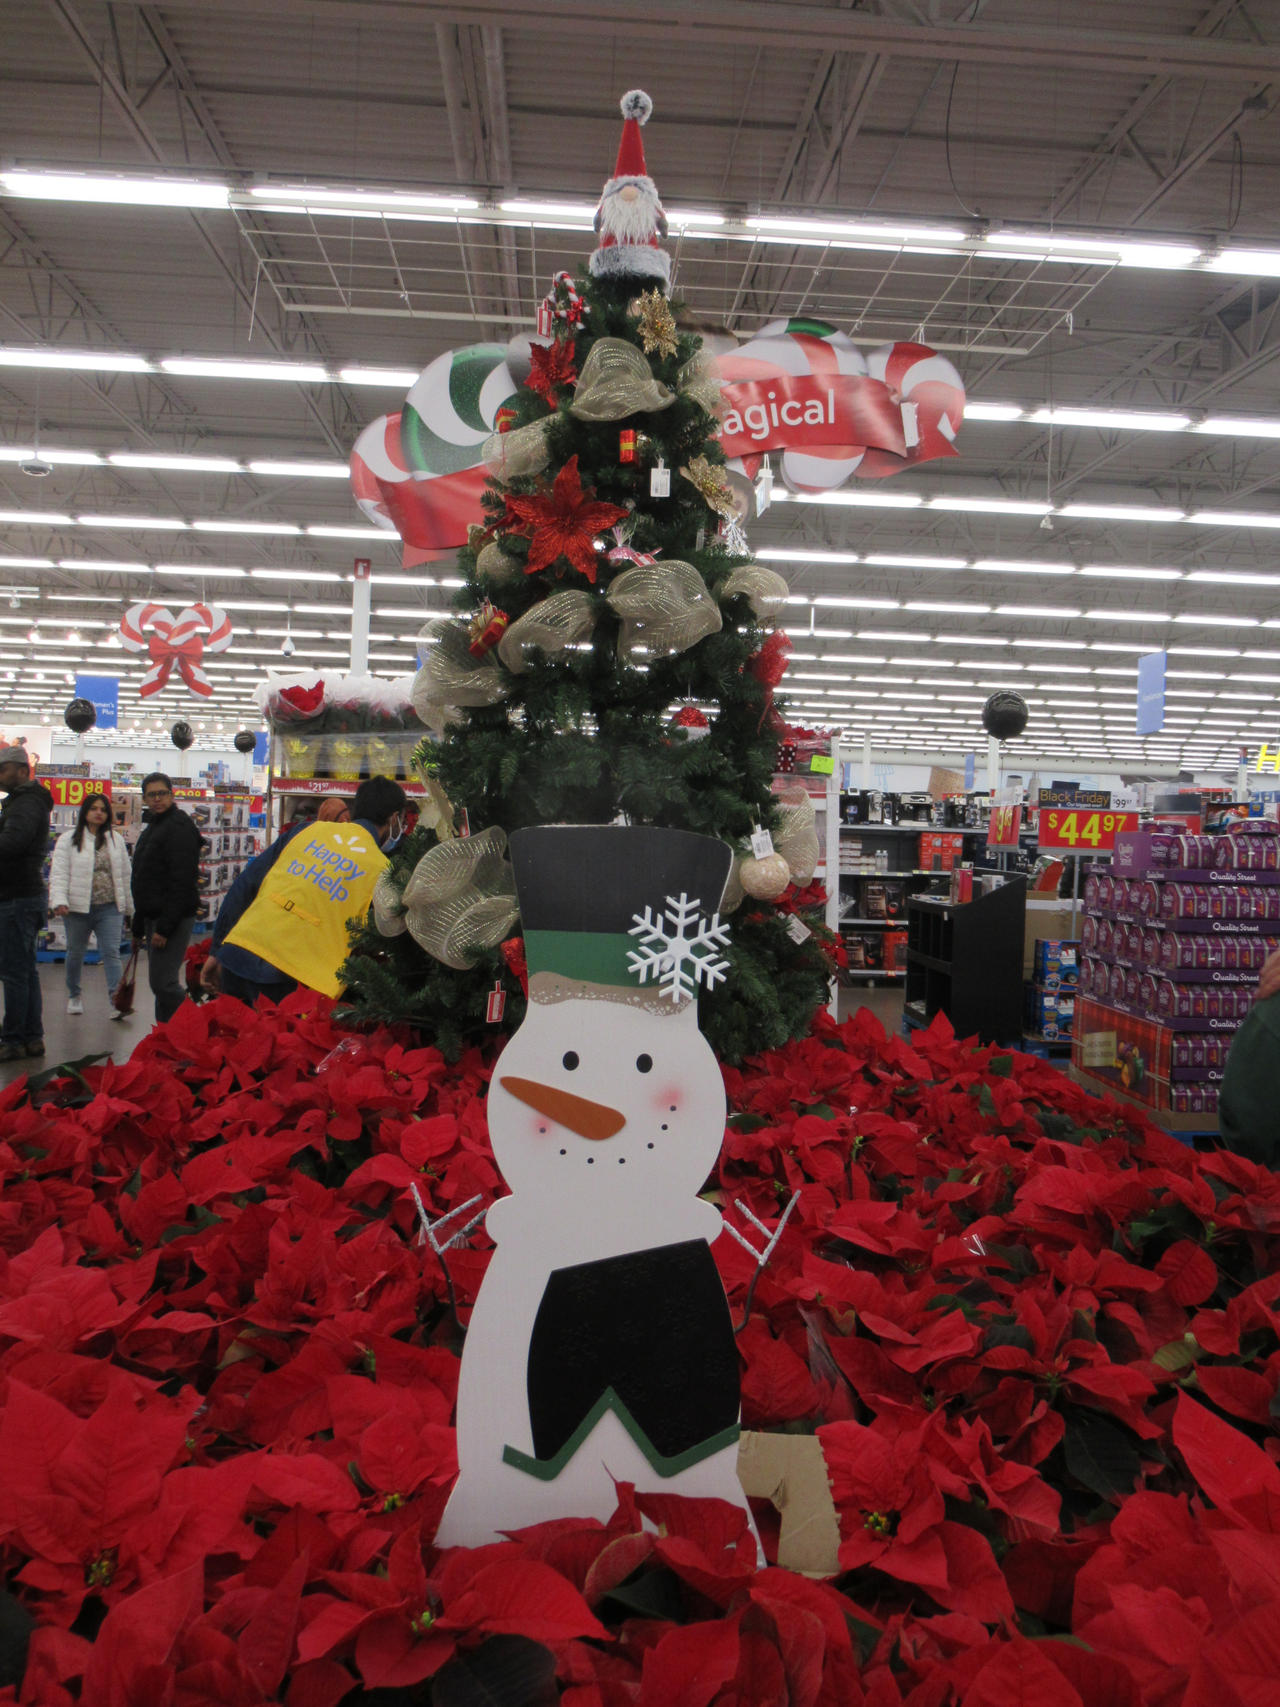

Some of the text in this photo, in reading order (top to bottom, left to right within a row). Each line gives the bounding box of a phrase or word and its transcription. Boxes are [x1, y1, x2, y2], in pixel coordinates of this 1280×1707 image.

[716, 388, 835, 440] agical
[1039, 789, 1110, 807] Black Friday
[304, 839, 366, 881] Happy
[287, 859, 349, 902] to Help
[1210, 871, 1256, 881] Quality Street
[1213, 922, 1259, 932] Quality Street
[1213, 972, 1239, 982] Quality
[1210, 1019, 1236, 1028] Quality
